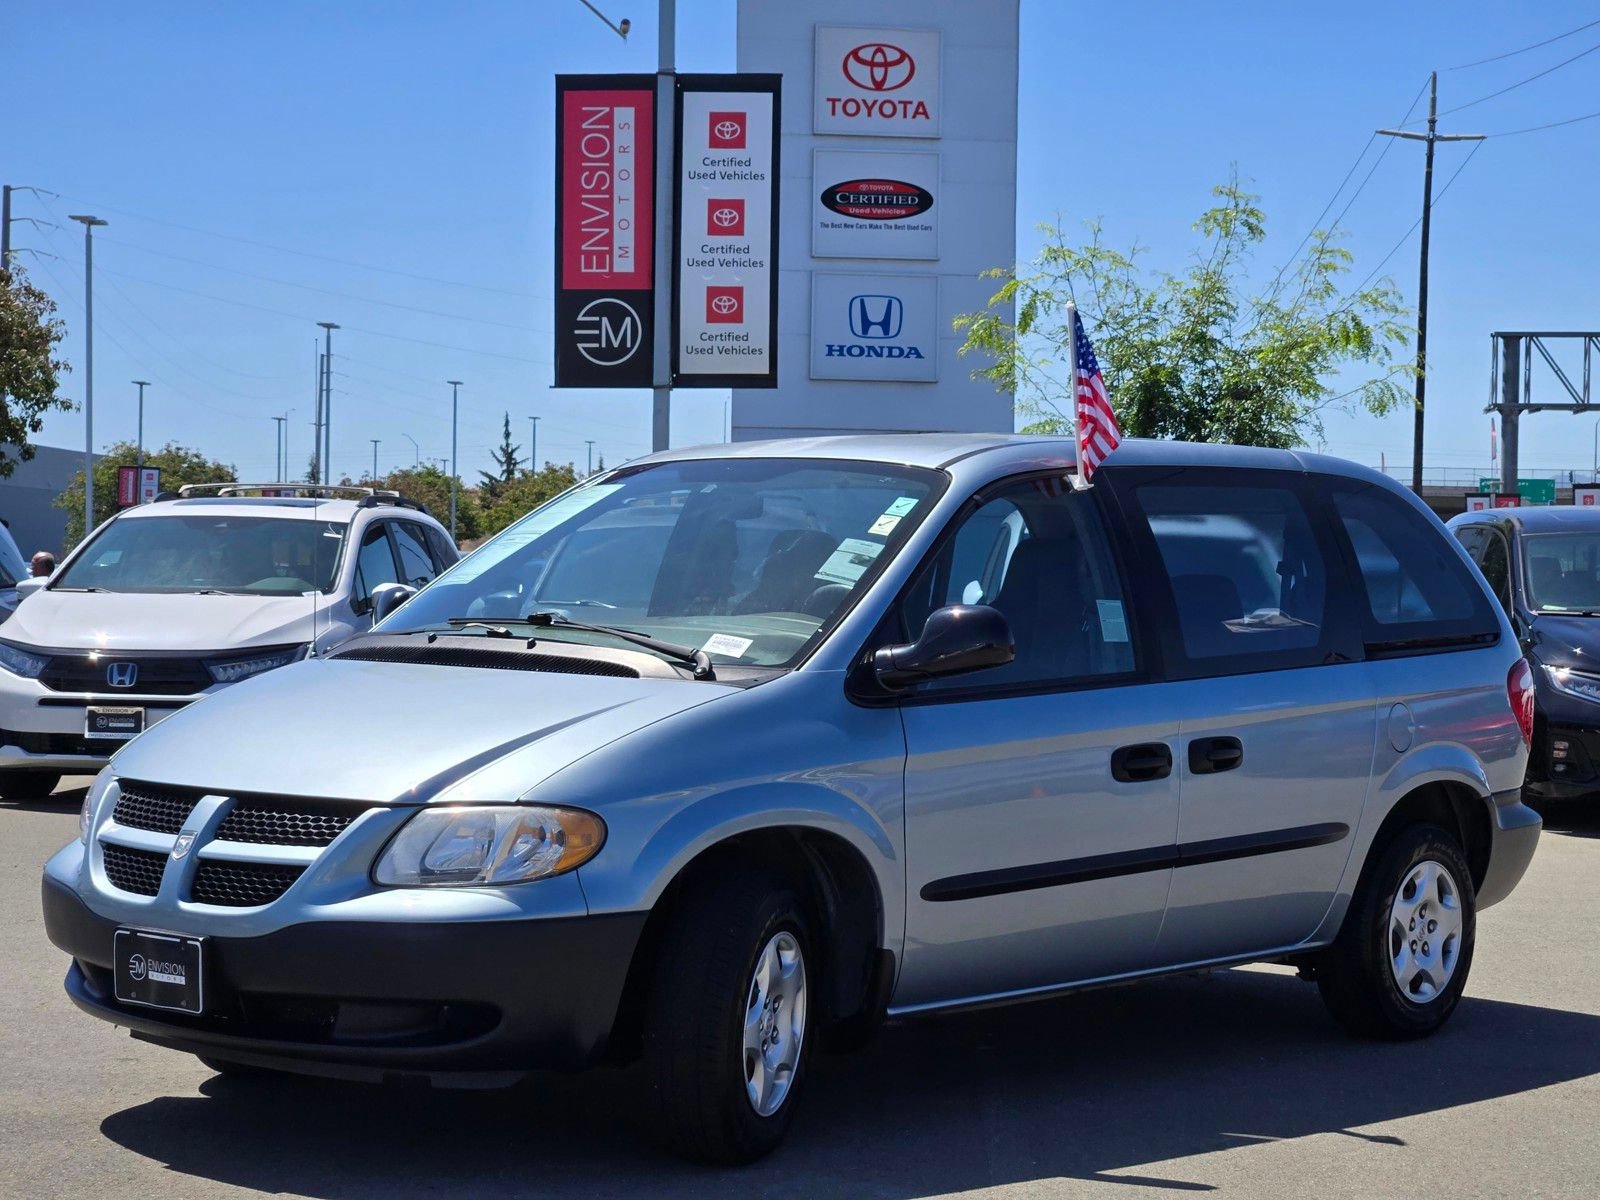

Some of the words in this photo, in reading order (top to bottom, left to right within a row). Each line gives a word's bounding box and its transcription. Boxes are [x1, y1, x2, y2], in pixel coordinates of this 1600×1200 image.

[826, 97, 930, 120] TOYOTA
[702, 156, 752, 167] Certified
[688, 170, 716, 180] Used
[719, 170, 765, 180] Vehicles
[581, 106, 610, 272] ENVISION
[618, 121, 630, 258] MOTORS
[836, 192, 919, 205] CERTIFIED
[872, 207, 906, 215] Vehicles
[701, 244, 750, 254] Certified
[687, 258, 715, 268] Used
[718, 258, 764, 268] Vehicles
[700, 332, 749, 342] Certified
[686, 345, 713, 355] Used
[717, 345, 763, 356] Vehicles
[825, 344, 925, 359] HONDA
[147, 958, 186, 976] ENVISION
